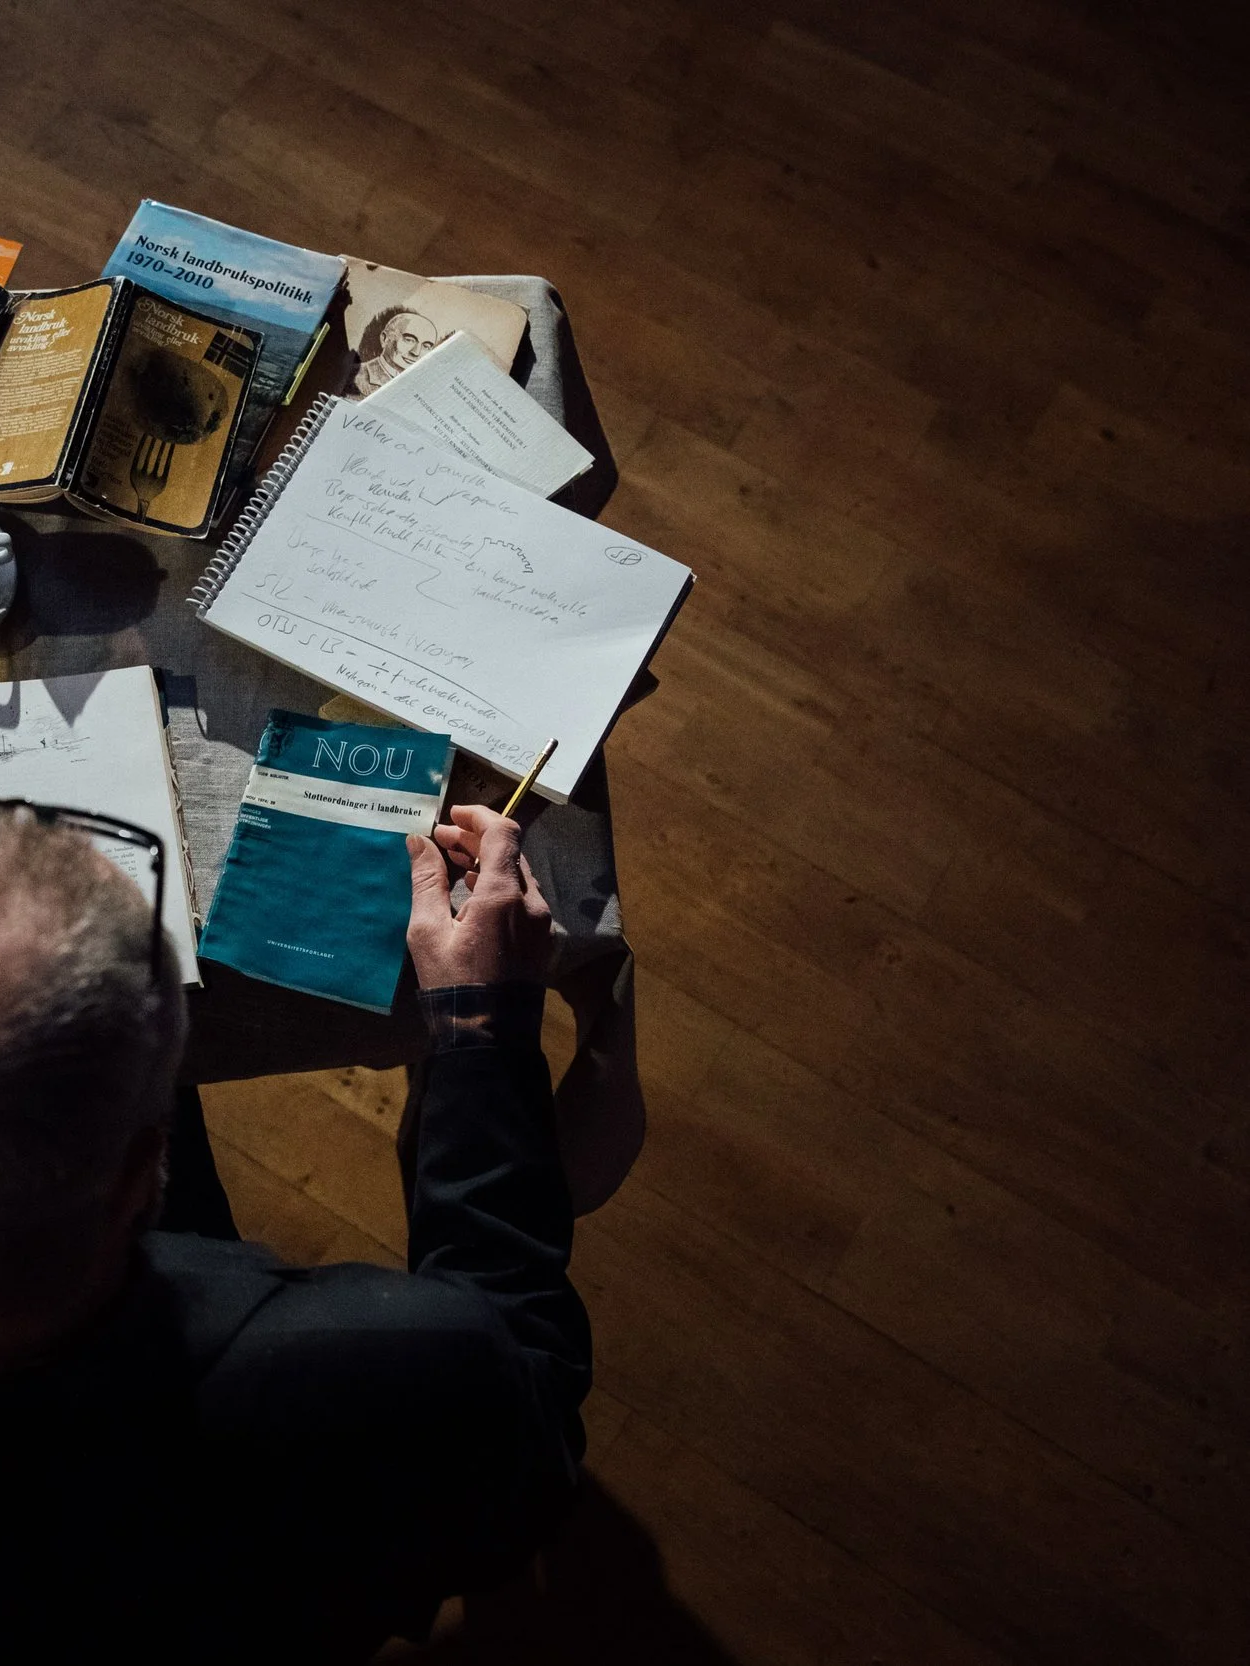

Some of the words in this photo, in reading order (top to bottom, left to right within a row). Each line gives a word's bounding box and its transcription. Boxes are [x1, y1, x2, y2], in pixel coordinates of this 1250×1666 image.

[135, 234, 179, 260] Norsk
[182, 252, 313, 305] landbrukspolitikk
[13, 309, 57, 325] Norsk
[138, 299, 185, 327] Norsk
[312, 737, 415, 780] NOU
[303, 790, 369, 810] Støtteordninger
[370, 802, 375, 811] i
[377, 803, 422, 817] landbruket
[266, 939, 335, 959] UNIVERSITETSFORLAGET
